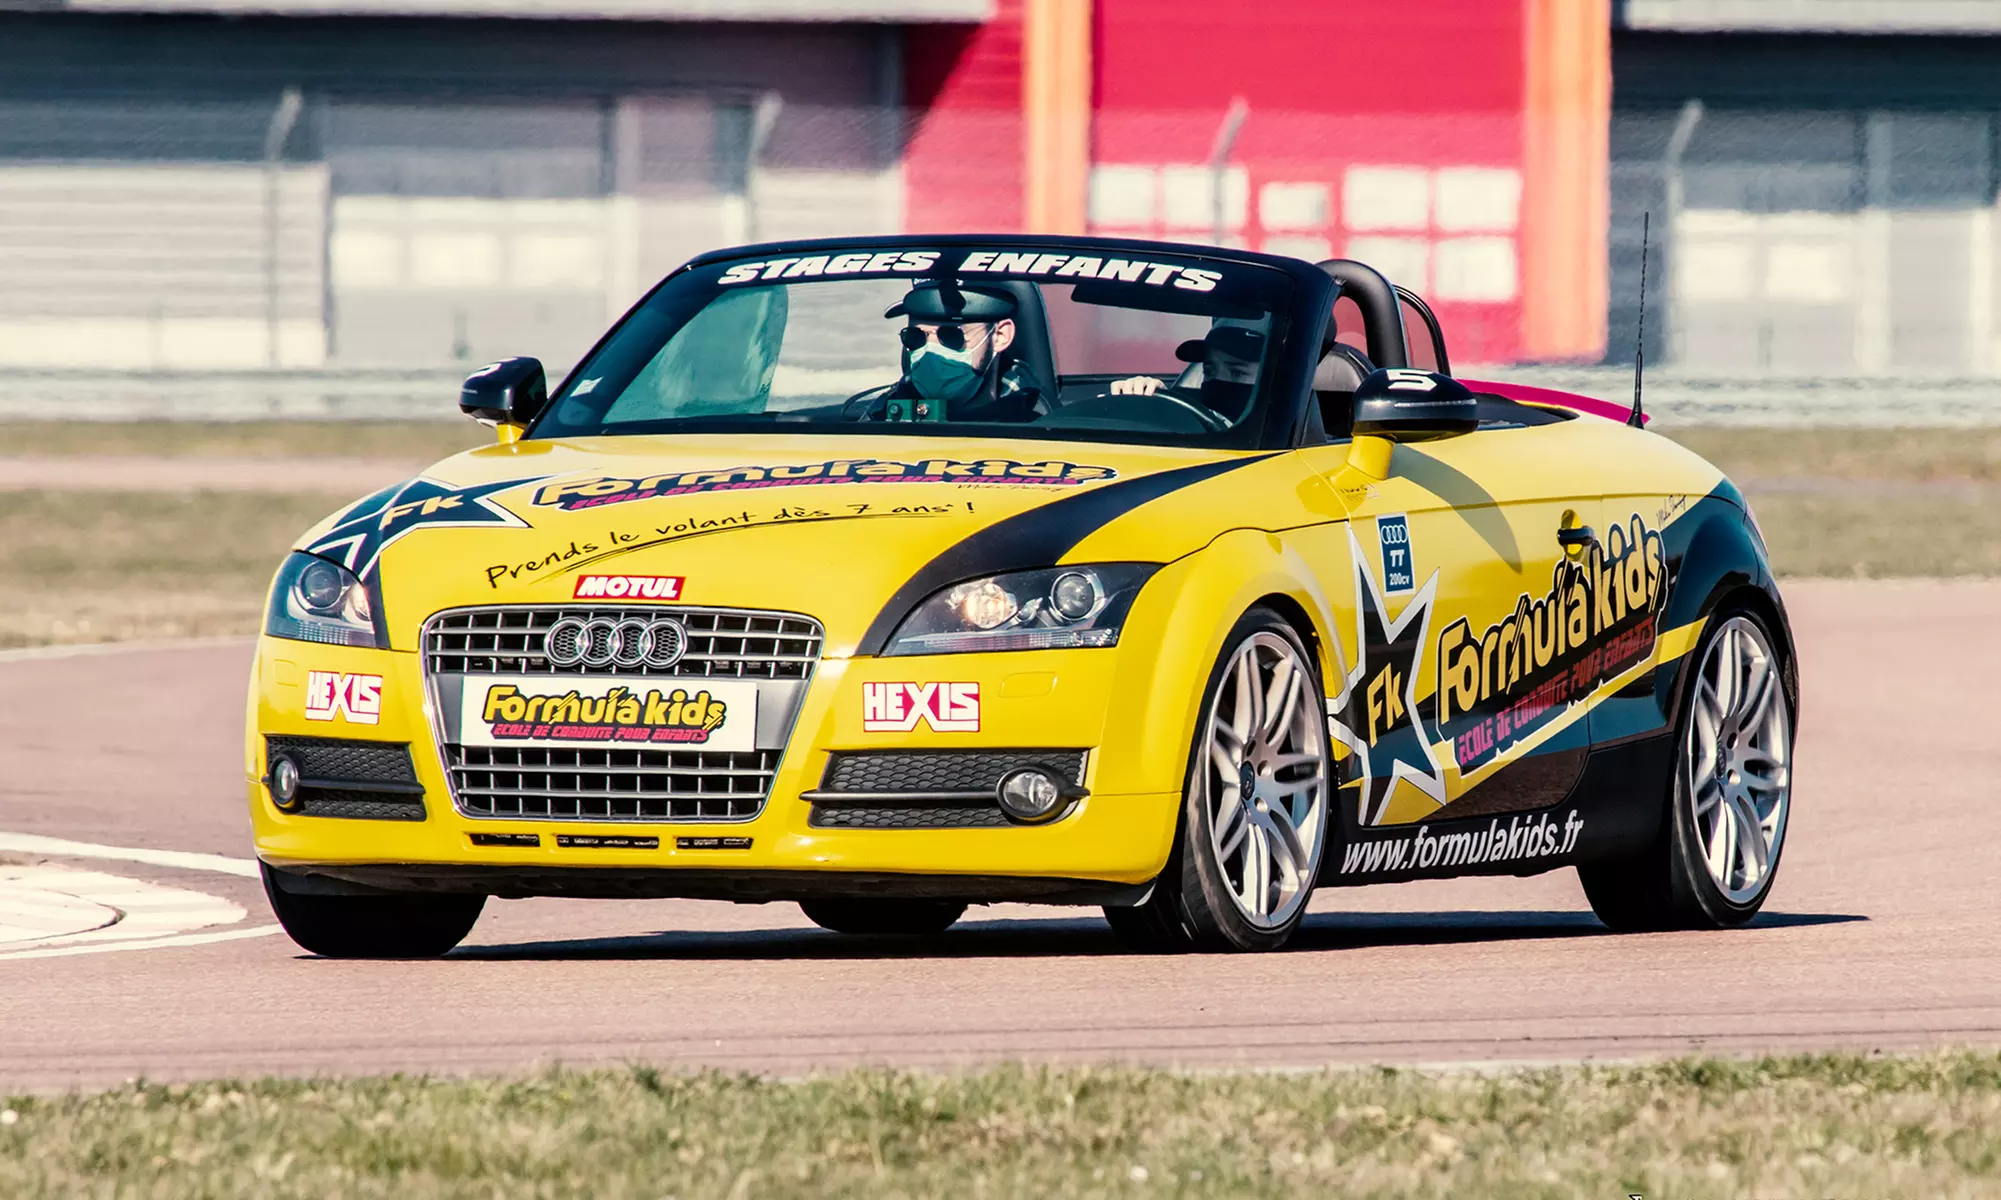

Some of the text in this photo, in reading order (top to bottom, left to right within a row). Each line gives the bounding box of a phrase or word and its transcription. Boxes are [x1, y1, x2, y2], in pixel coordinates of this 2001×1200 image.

[718, 251, 1224, 293] STAGES ENFANTS
[1386, 369, 1438, 392] 5
[922, 459, 1112, 482] kids
[485, 541, 598, 589] Prends
[610, 530, 640, 545] le
[656, 511, 757, 535] volant
[774, 506, 831, 520] dès
[846, 503, 873, 515] 7
[1389, 548, 1405, 567] TT
[576, 576, 679, 598] MOTUL
[1440, 516, 1663, 725] Formula kids
[305, 669, 382, 725] HEXIS
[483, 685, 727, 730] Formula kids
[862, 681, 980, 732] HEXIS
[1340, 809, 1585, 875] www.formulakids.fr
